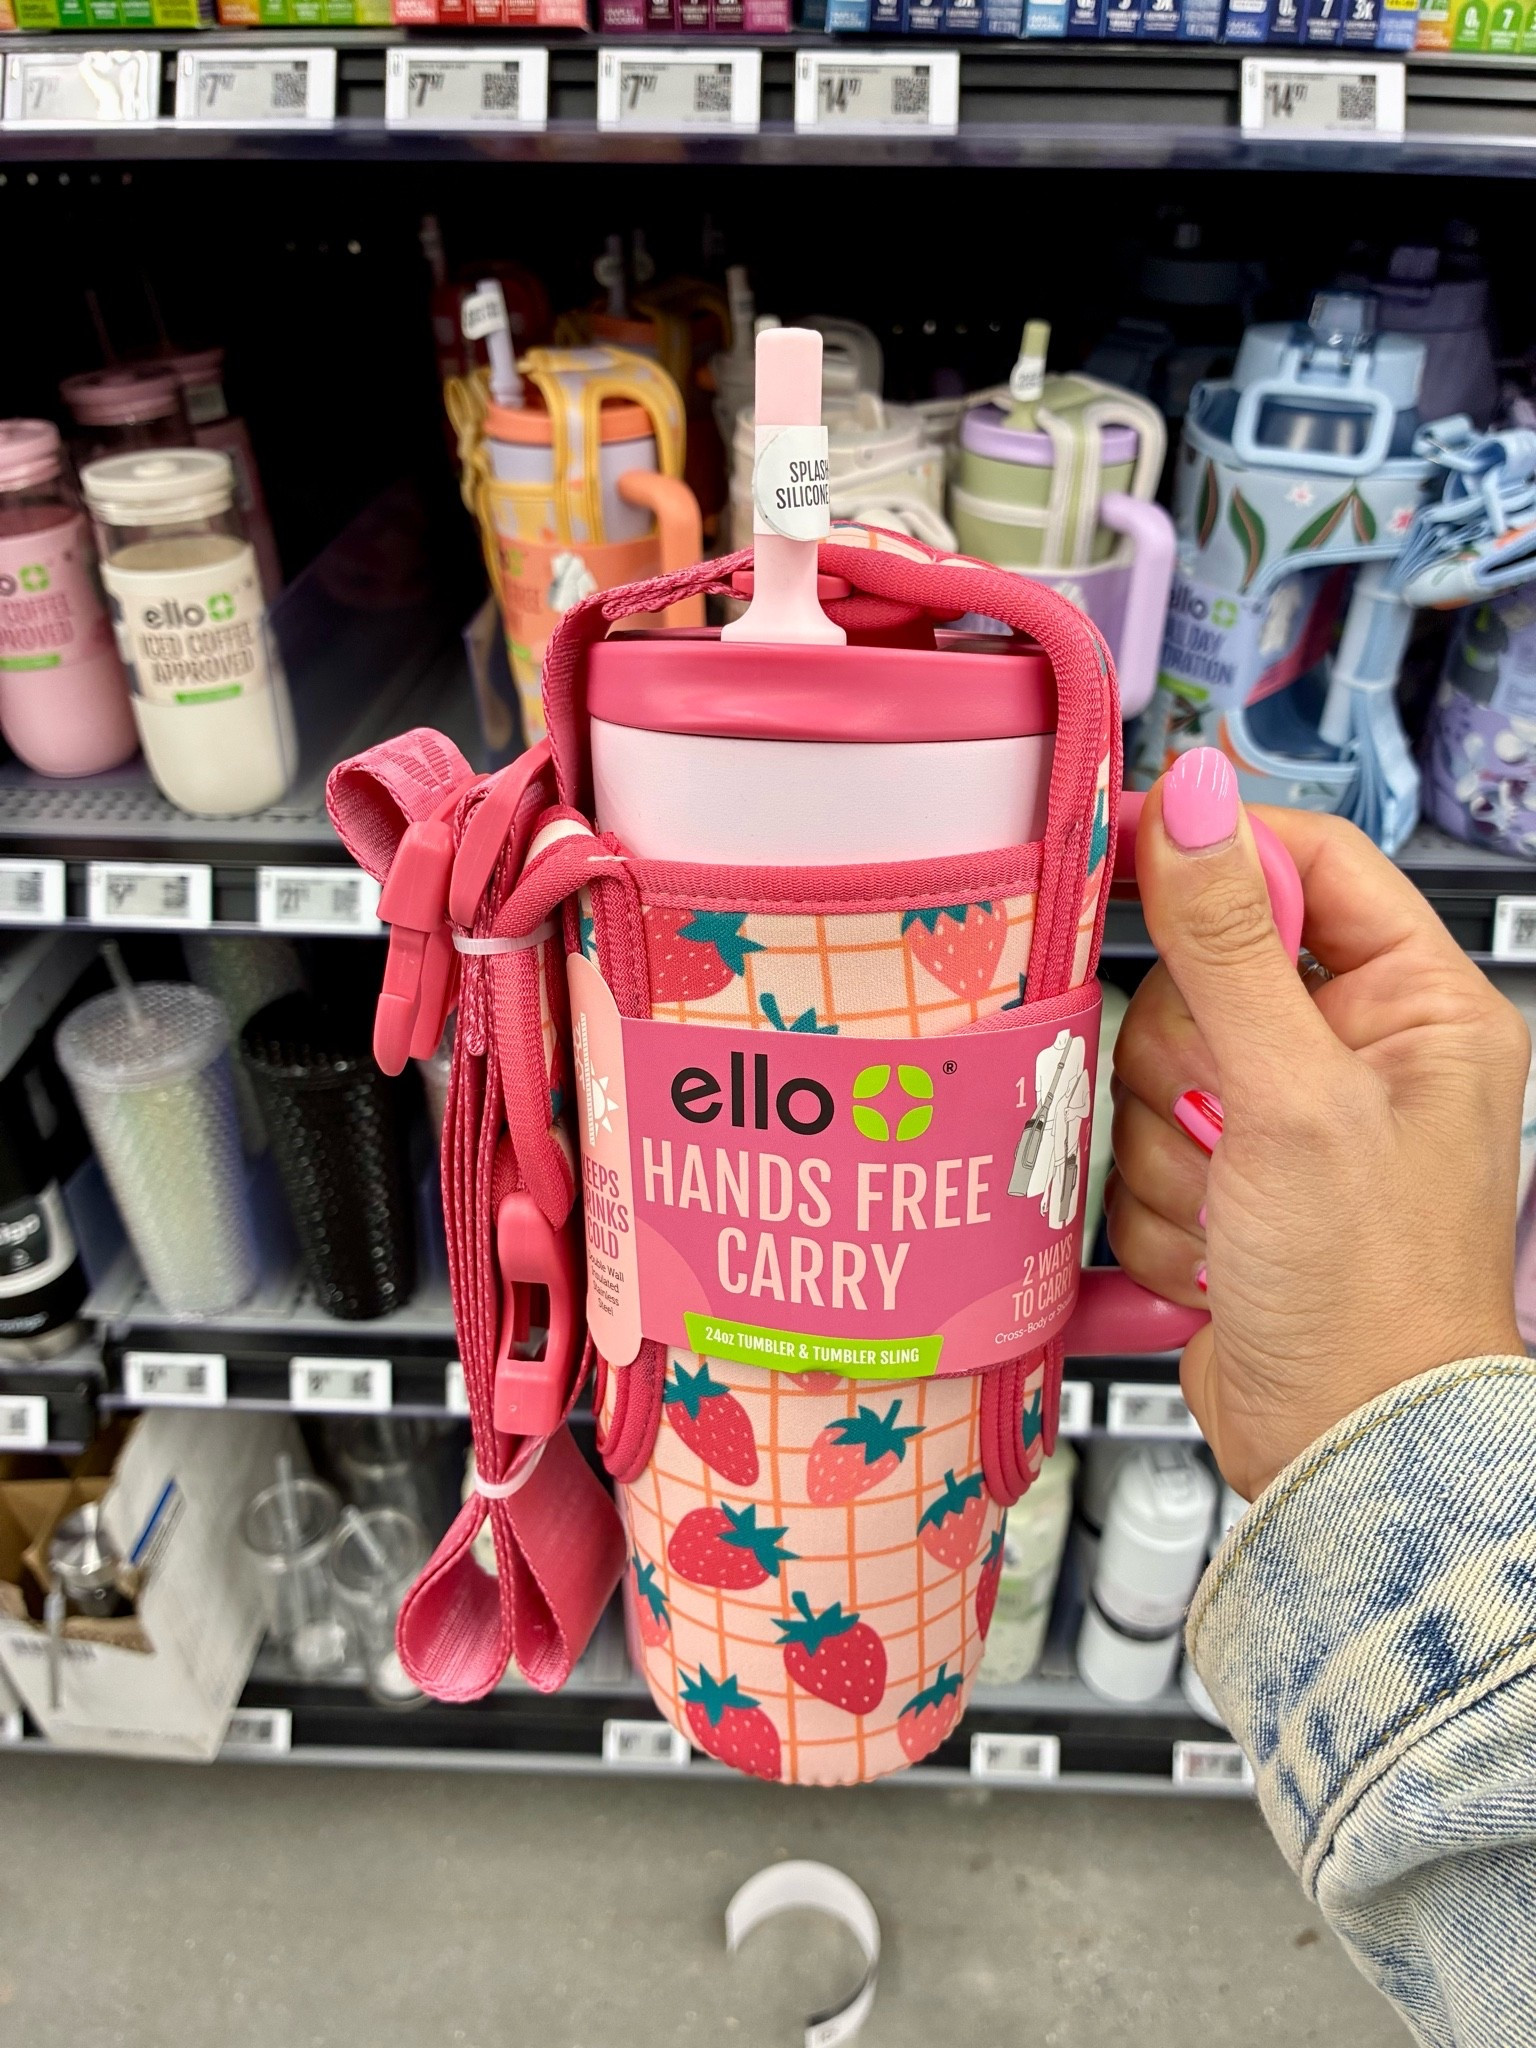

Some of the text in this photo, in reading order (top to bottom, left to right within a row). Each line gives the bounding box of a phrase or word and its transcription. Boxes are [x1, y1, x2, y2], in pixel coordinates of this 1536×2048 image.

[775, 483, 830, 509] SILICONE
[143, 599, 206, 630] ello
[152, 648, 256, 685] APPROVED
[671, 1051, 835, 1136] ello
[1015, 1076, 1027, 1109] 1
[642, 1136, 993, 1232] HANDS FREE
[587, 1218, 619, 1260] COLD
[607, 1267, 625, 1283] Wall
[717, 1226, 911, 1311] CARRY
[1022, 1232, 1073, 1287] 2 WAYS
[591, 1265, 620, 1294] Insulated
[593, 1280, 620, 1307] Stainless
[1012, 1258, 1074, 1322] TO CARRY
[598, 1297, 614, 1317] Steel
[994, 1316, 1047, 1344] Cross-Body
[1048, 1311, 1057, 1321] or
[705, 1326, 920, 1365] 24oz TUMBLER & TUMBLER SLING
